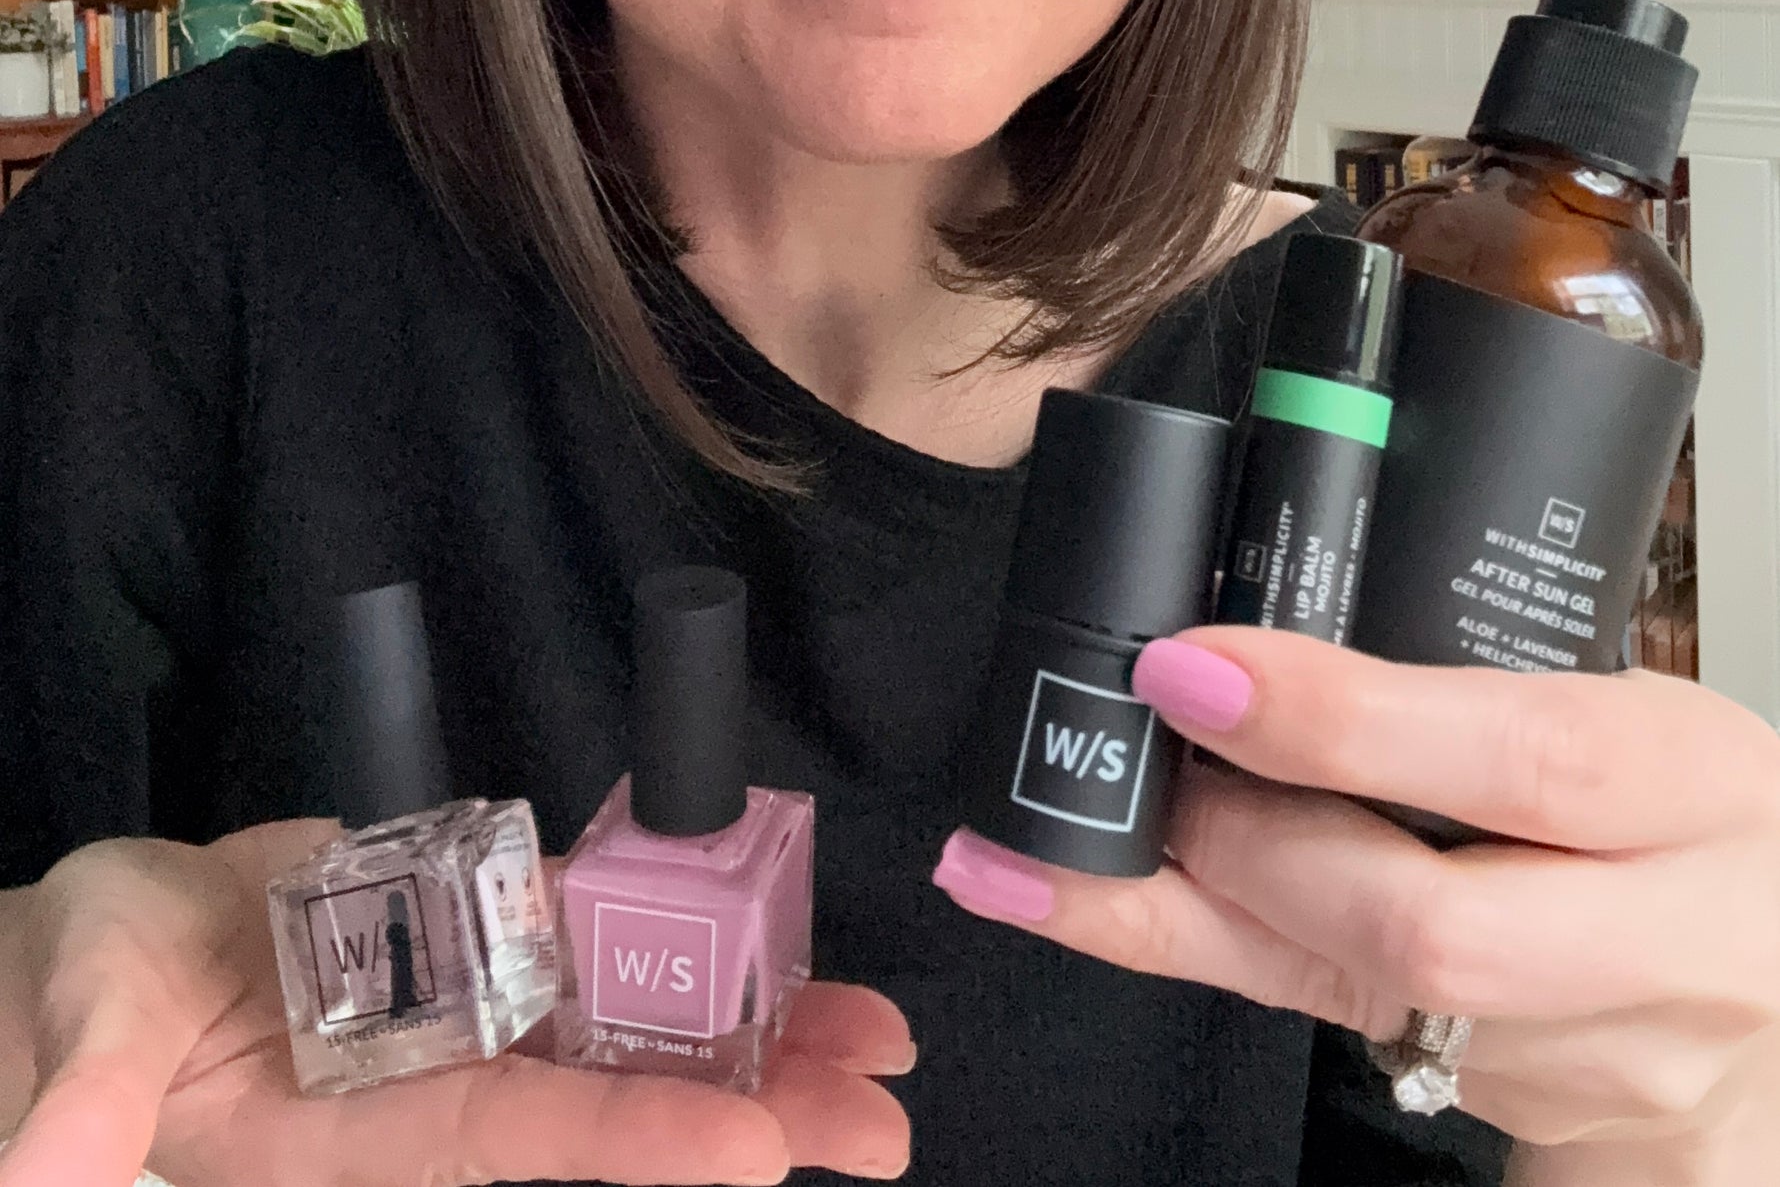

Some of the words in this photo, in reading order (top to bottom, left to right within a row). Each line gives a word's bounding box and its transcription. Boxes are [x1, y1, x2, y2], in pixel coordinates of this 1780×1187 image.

[1299, 535, 1322, 588] BALM
[1314, 550, 1337, 612] MOJITO
[1294, 590, 1312, 619] LIP
[1451, 577, 1479, 599] GEL
[1481, 589, 1523, 613] POUR
[1470, 559, 1530, 593] AFTER
[1534, 581, 1568, 607] SUN
[1569, 594, 1595, 616] GEL
[1456, 616, 1499, 641] ALOE
[1513, 636, 1577, 667] LAVENDER
[1044, 722, 1128, 782] W/S
[613, 946, 694, 994] W/S
[592, 1029, 646, 1050] 15-FREE
[656, 1040, 693, 1056] SANS
[697, 1047, 714, 1059] 15
